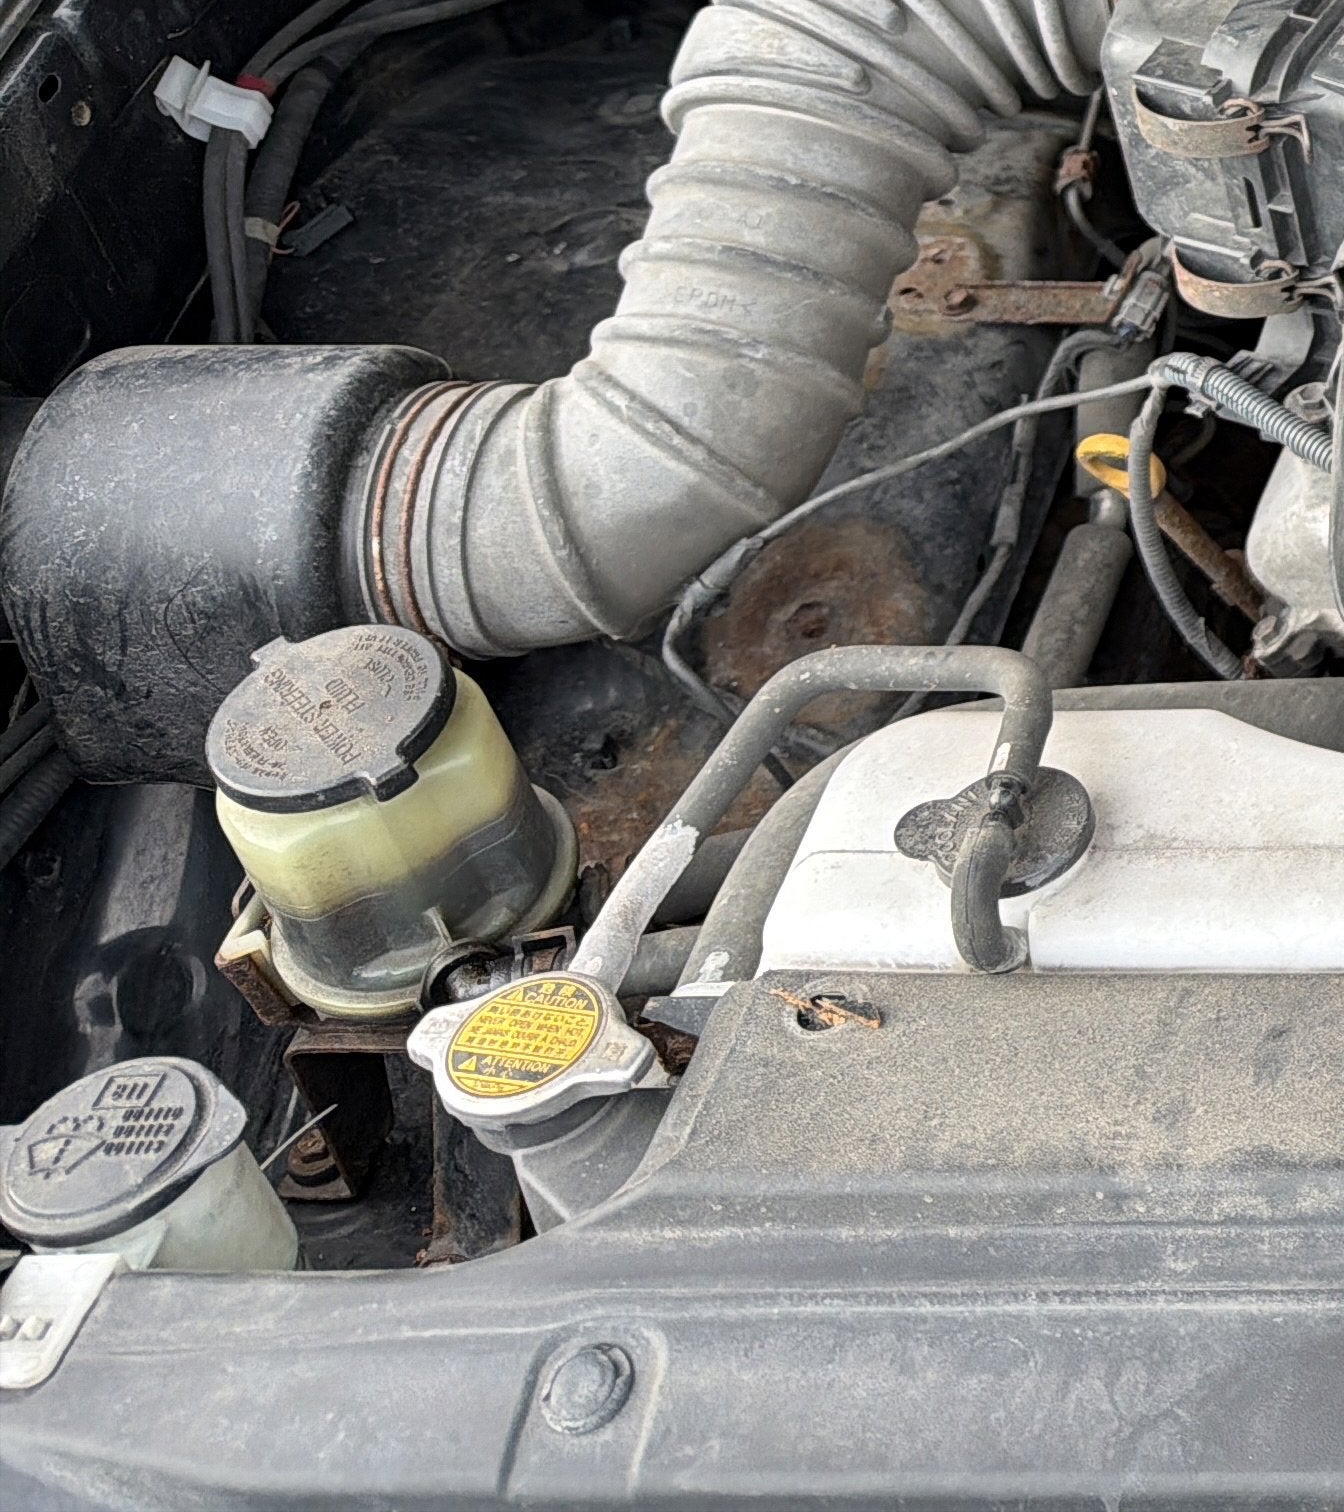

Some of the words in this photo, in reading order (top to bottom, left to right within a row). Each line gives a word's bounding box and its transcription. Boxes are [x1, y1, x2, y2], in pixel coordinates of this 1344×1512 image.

[264, 667, 318, 725] STEERING
[325, 677, 366, 715] FLUID
[313, 718, 363, 767] POWER
[524, 992, 589, 1011] CAUTION
[508, 1018, 533, 1030] OPEN
[480, 1055, 553, 1075] ATTENTION
